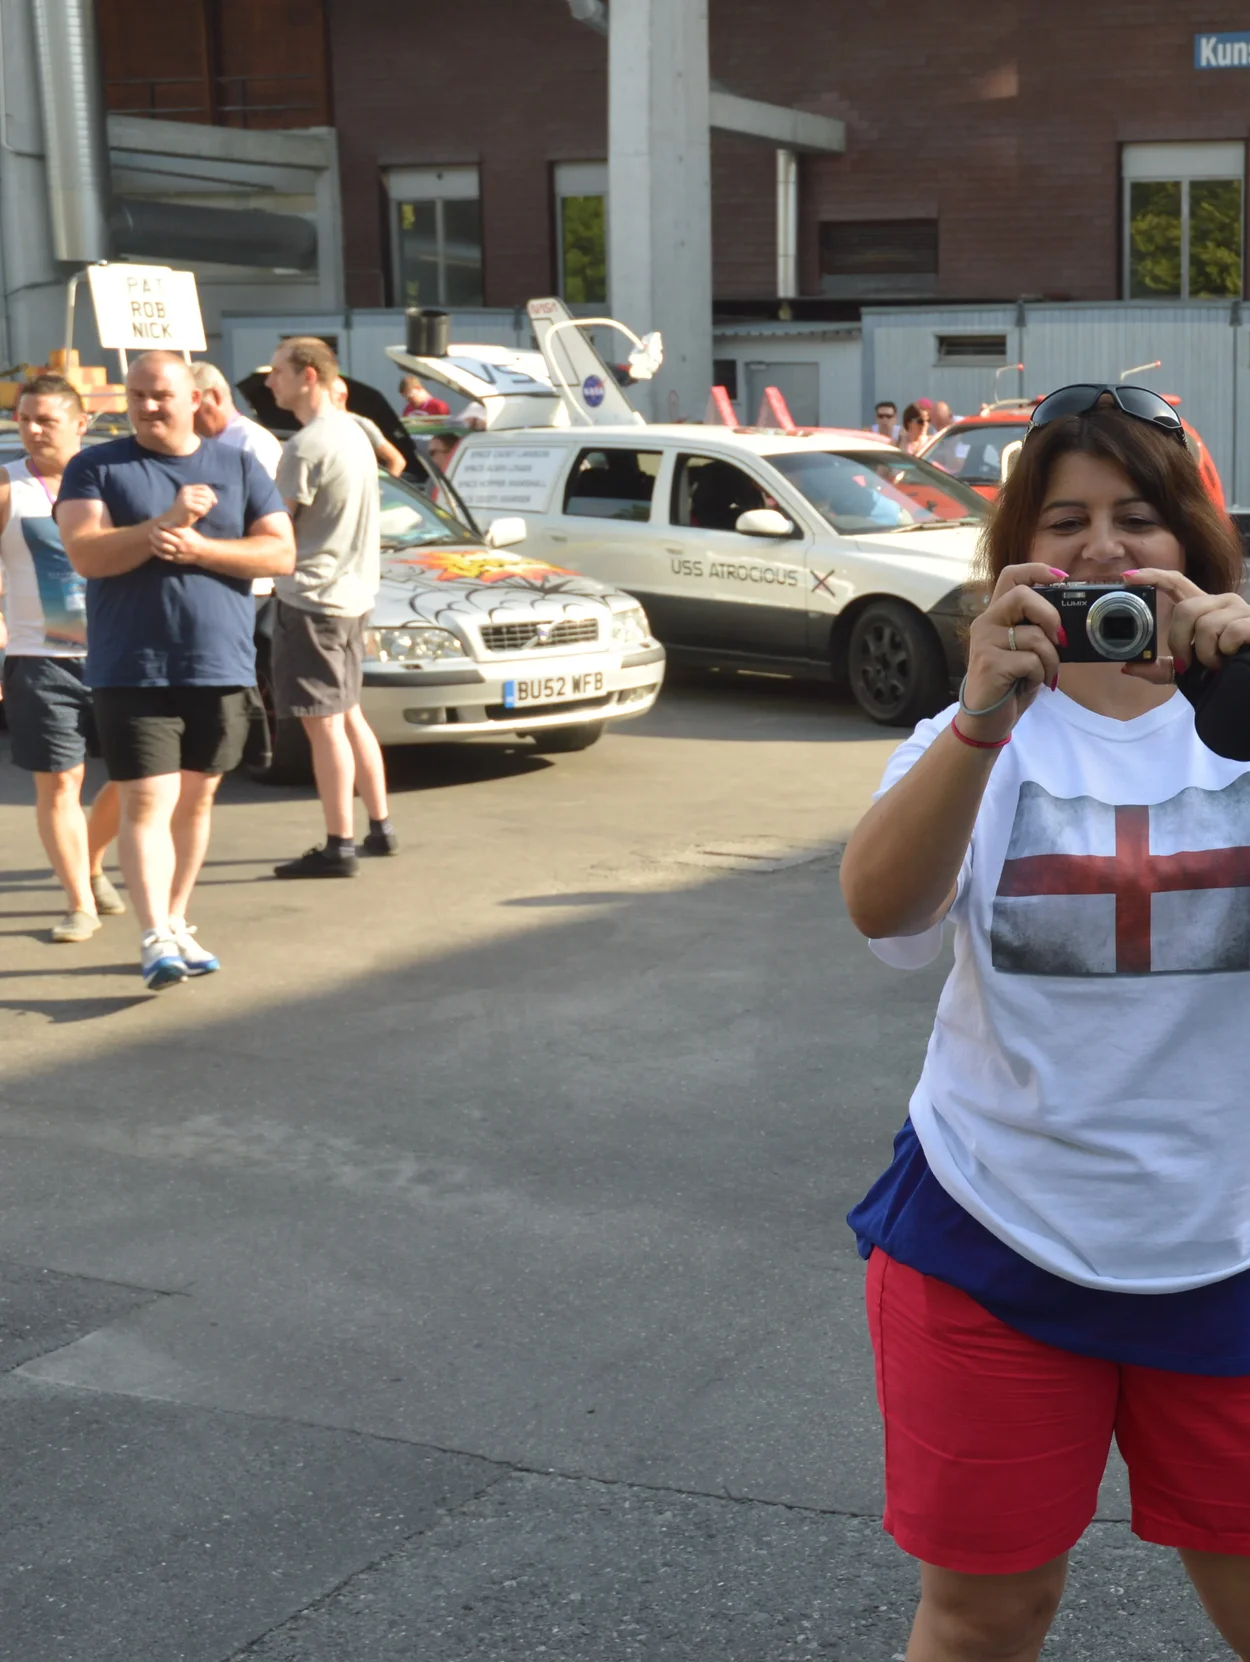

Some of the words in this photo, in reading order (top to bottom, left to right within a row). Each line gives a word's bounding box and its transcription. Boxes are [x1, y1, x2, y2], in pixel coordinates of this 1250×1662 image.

[126, 276, 163, 294] PAT
[130, 300, 166, 319] ROB
[131, 321, 173, 339] NICK
[671, 559, 703, 577] USS
[708, 562, 799, 587] ATROCIOUS
[517, 676, 566, 701] BU52
[572, 671, 604, 695] WFB
